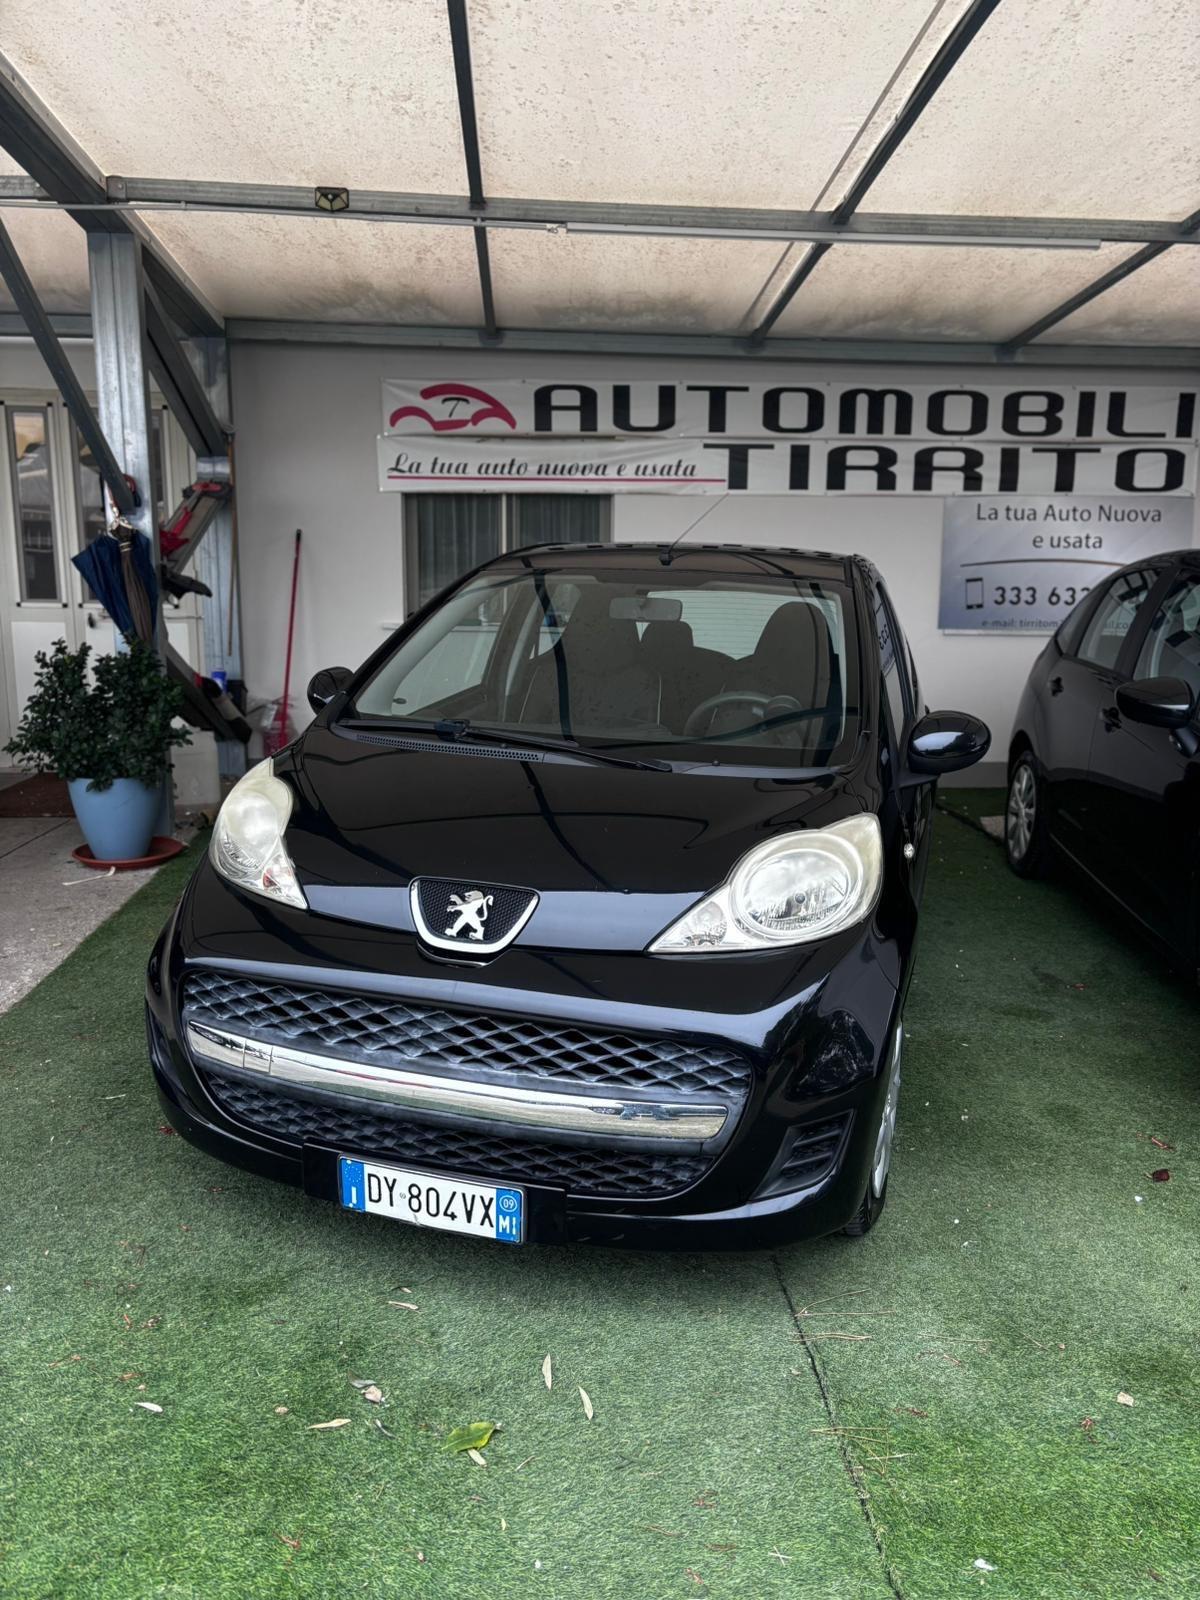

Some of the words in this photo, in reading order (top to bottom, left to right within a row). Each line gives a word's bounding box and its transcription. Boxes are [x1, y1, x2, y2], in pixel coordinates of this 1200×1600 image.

[533, 384, 1196, 439] AUTOMOBILI
[387, 452, 422, 476] La
[431, 456, 469, 475] tua
[477, 456, 528, 477] auto
[537, 462, 608, 477] nuova
[616, 462, 626, 477] e
[634, 461, 698, 478] usata
[703, 443, 1187, 493] TIRRITO
[976, 503, 998, 521] La
[1005, 505, 1037, 522] tua
[1044, 504, 1092, 522] Auto
[1098, 504, 1162, 523] Nuova
[1032, 535, 1044, 549] e
[1051, 533, 1103, 549] usata
[994, 586, 1037, 605] 333
[982, 617, 1017, 628] e-mail:
[367, 1173, 397, 1207] DY
[407, 1183, 495, 1228] 804VX
[502, 1199, 514, 1209] 09
[498, 1215, 517, 1235] MI
